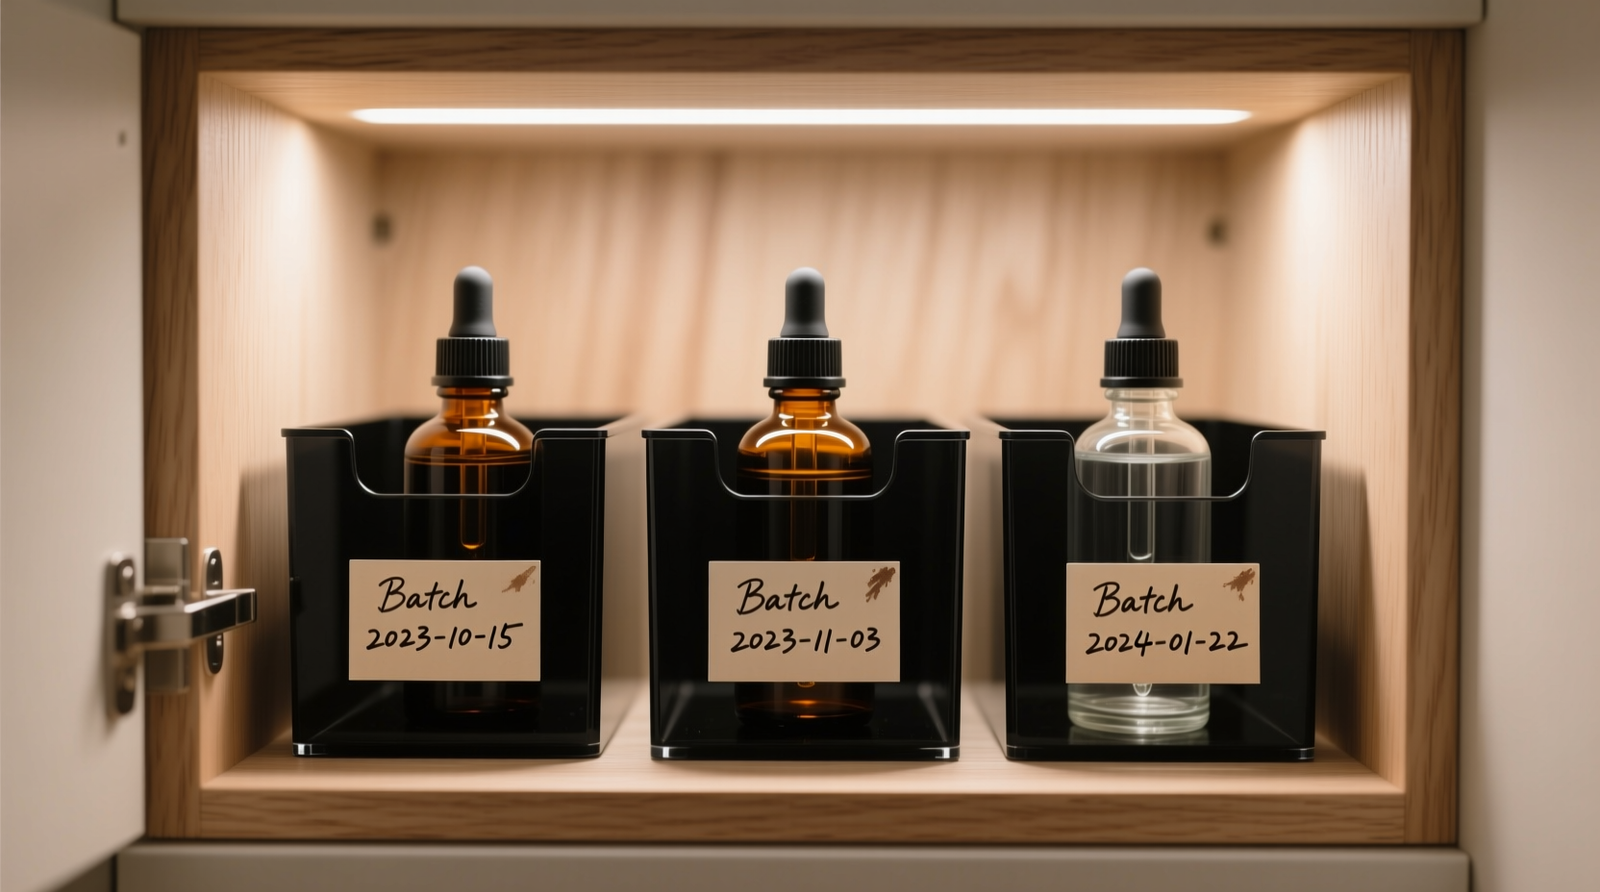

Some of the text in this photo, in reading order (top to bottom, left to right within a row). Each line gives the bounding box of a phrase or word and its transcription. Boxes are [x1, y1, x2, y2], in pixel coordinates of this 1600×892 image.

[377, 576, 478, 614] Batch
[736, 577, 840, 616] Batch
[1093, 581, 1194, 618] Batch
[365, 622, 524, 652] 2023-10-15
[730, 626, 881, 655] 2023-11-03
[1085, 630, 1249, 658] 2024-01-22
